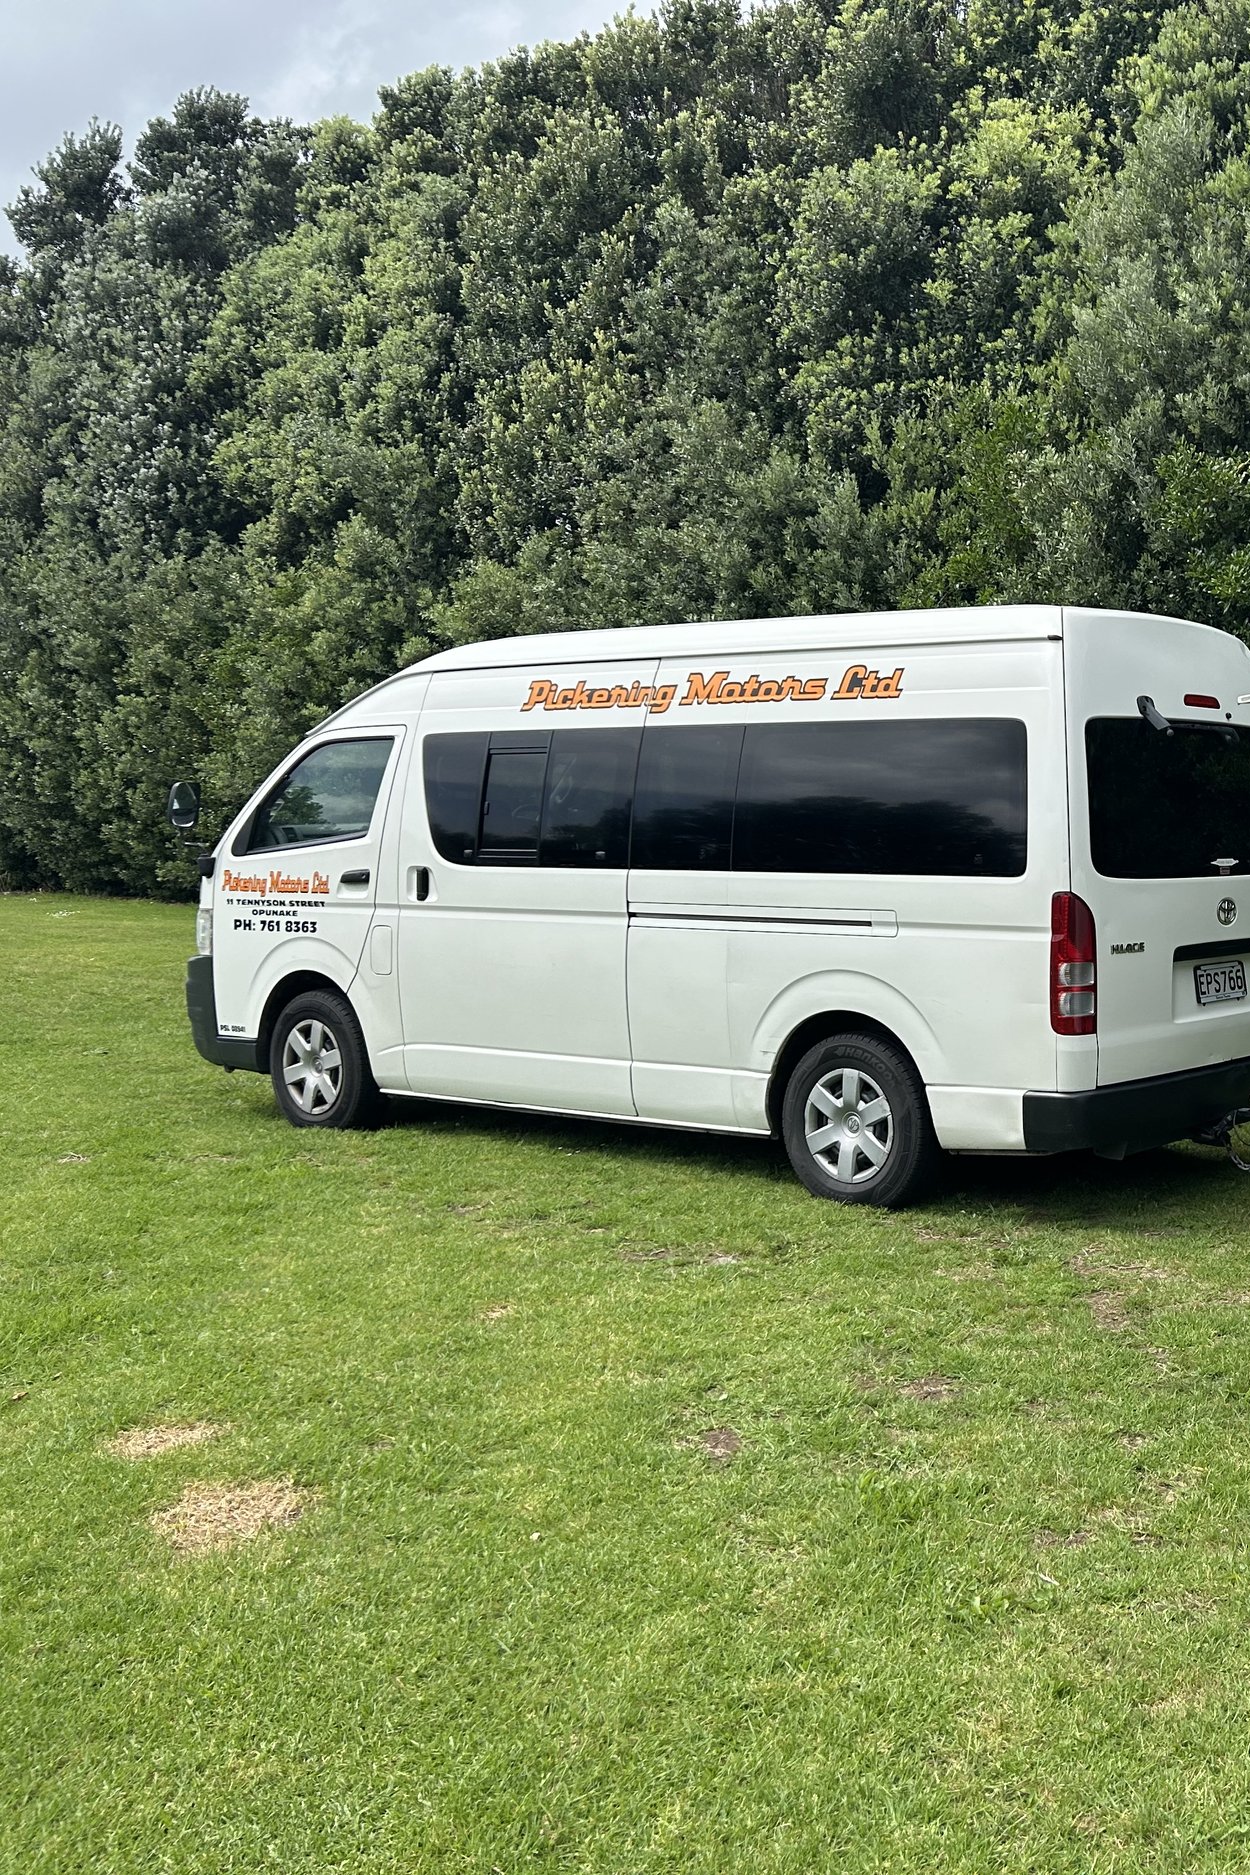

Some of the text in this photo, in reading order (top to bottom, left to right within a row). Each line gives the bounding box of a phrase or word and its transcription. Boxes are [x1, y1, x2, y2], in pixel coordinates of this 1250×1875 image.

[520, 664, 904, 713] Pickering Motors Ltd
[222, 870, 267, 897] Pickering
[269, 871, 309, 893] Motors
[236, 899, 286, 907] TENNYSON
[252, 909, 298, 917] OPUNAKE
[234, 919, 318, 933] PH: 761 8363
[1110, 942, 1145, 955] HIACE
[1198, 968, 1244, 996] EPS766
